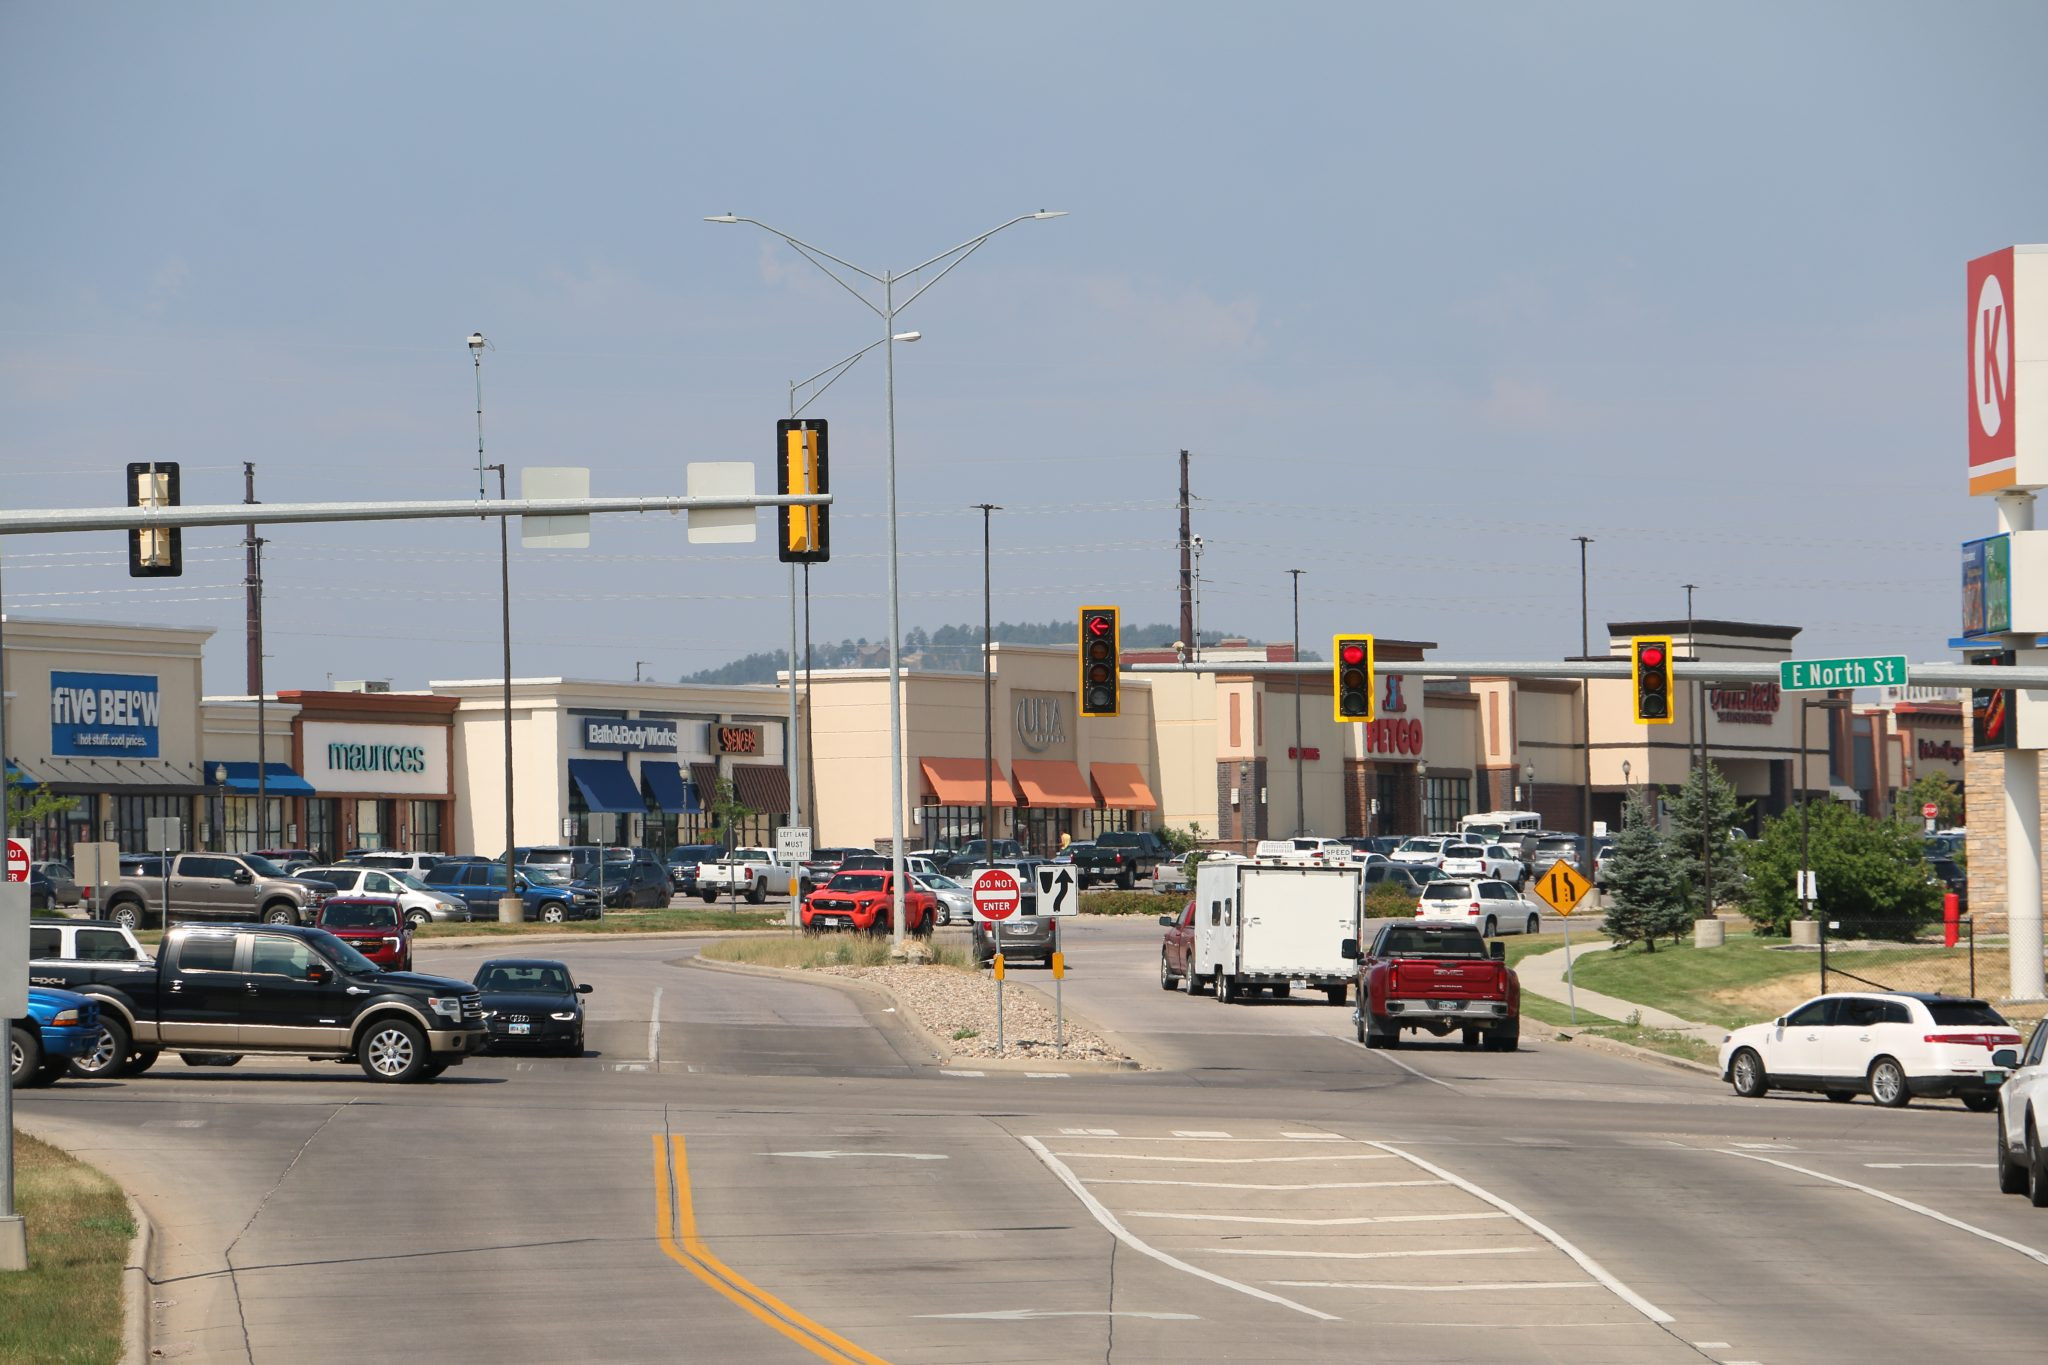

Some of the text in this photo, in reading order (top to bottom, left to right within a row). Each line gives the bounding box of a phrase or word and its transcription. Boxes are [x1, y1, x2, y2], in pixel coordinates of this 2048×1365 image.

[1792, 660, 1895, 687] E North St
[80, 733, 92, 745] hot
[110, 734, 125, 746] cool
[588, 724, 612, 744] Bath
[619, 725, 648, 750] Body
[645, 727, 678, 748] Works
[1367, 718, 1423, 755] PETCO
[328, 743, 425, 773] maurices
[784, 840, 804, 848] MUST
[8, 849, 22, 859] OT
[1325, 848, 1350, 856] SPEED
[979, 879, 1013, 889] DO NOT
[983, 901, 1010, 911] ENTER
